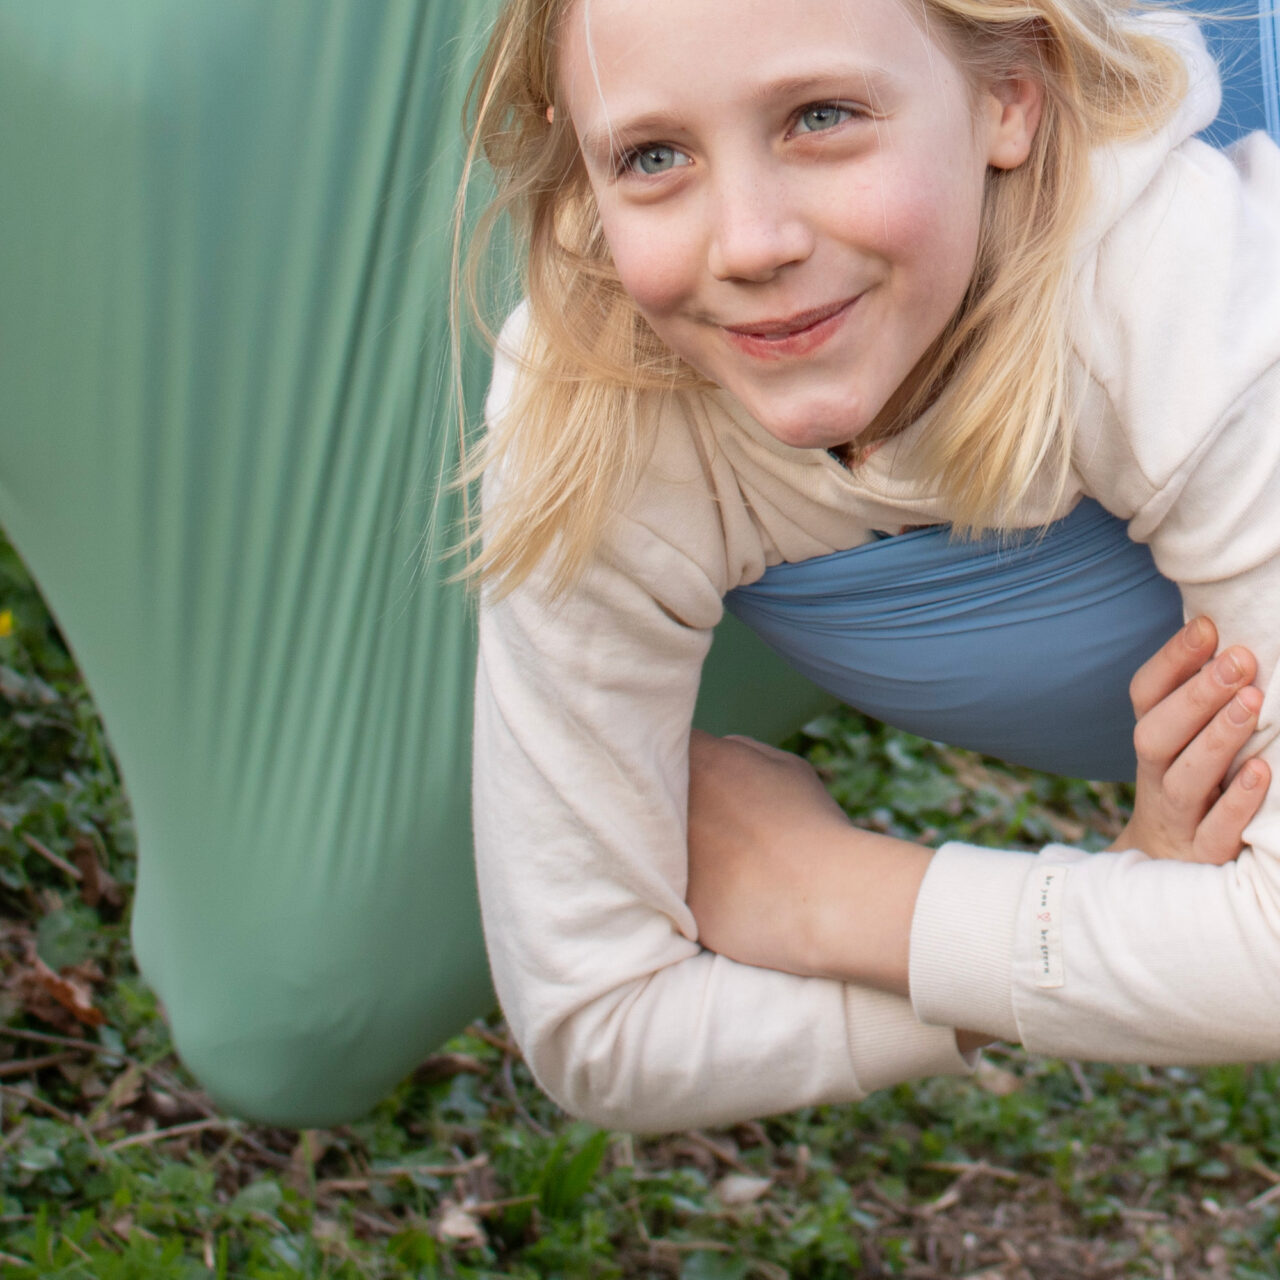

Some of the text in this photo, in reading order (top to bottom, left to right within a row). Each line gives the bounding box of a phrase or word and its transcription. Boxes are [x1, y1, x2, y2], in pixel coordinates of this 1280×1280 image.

[1040, 889, 1049, 907] you
[1040, 929, 1049, 941] be
[1040, 945, 1050, 973] green
